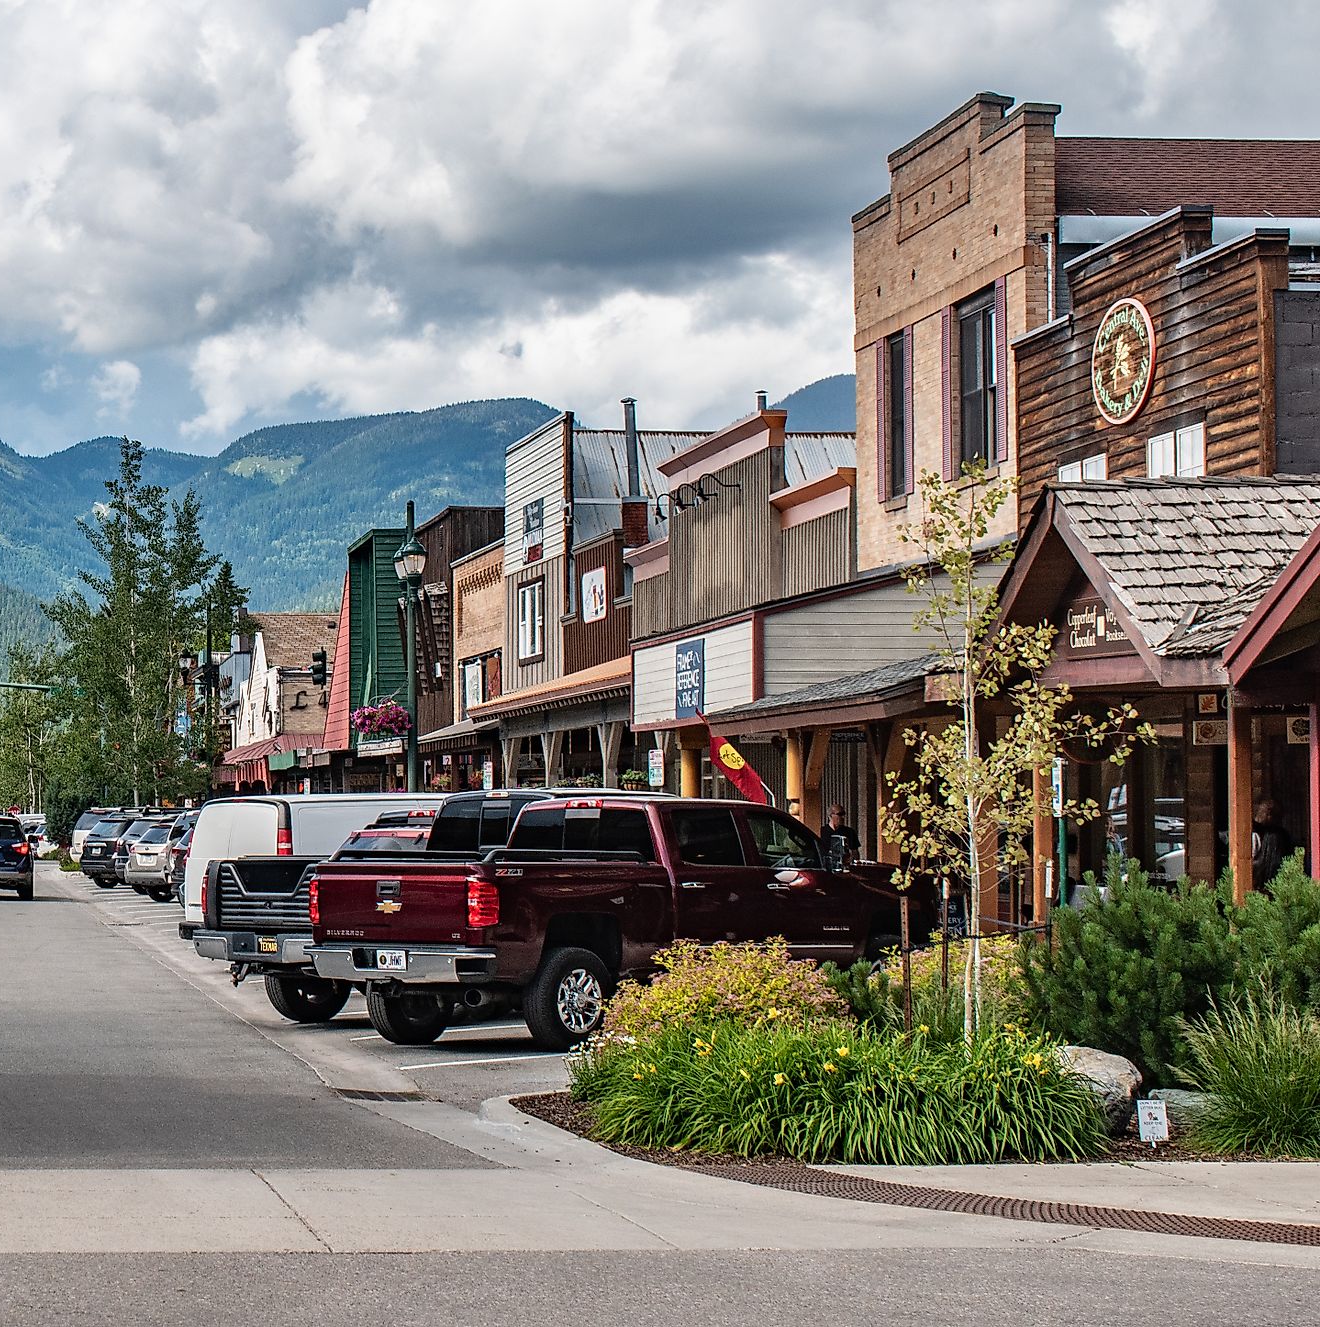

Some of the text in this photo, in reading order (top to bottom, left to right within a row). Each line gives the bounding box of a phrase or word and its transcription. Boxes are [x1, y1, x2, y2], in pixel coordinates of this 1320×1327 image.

[1098, 306, 1146, 353] Central Ave.
[1095, 356, 1149, 417] Bakery & Deli
[1067, 605, 1097, 630] Copperleaf
[1069, 629, 1097, 648] Chocolat
[326, 929, 365, 937] SILVERADO
